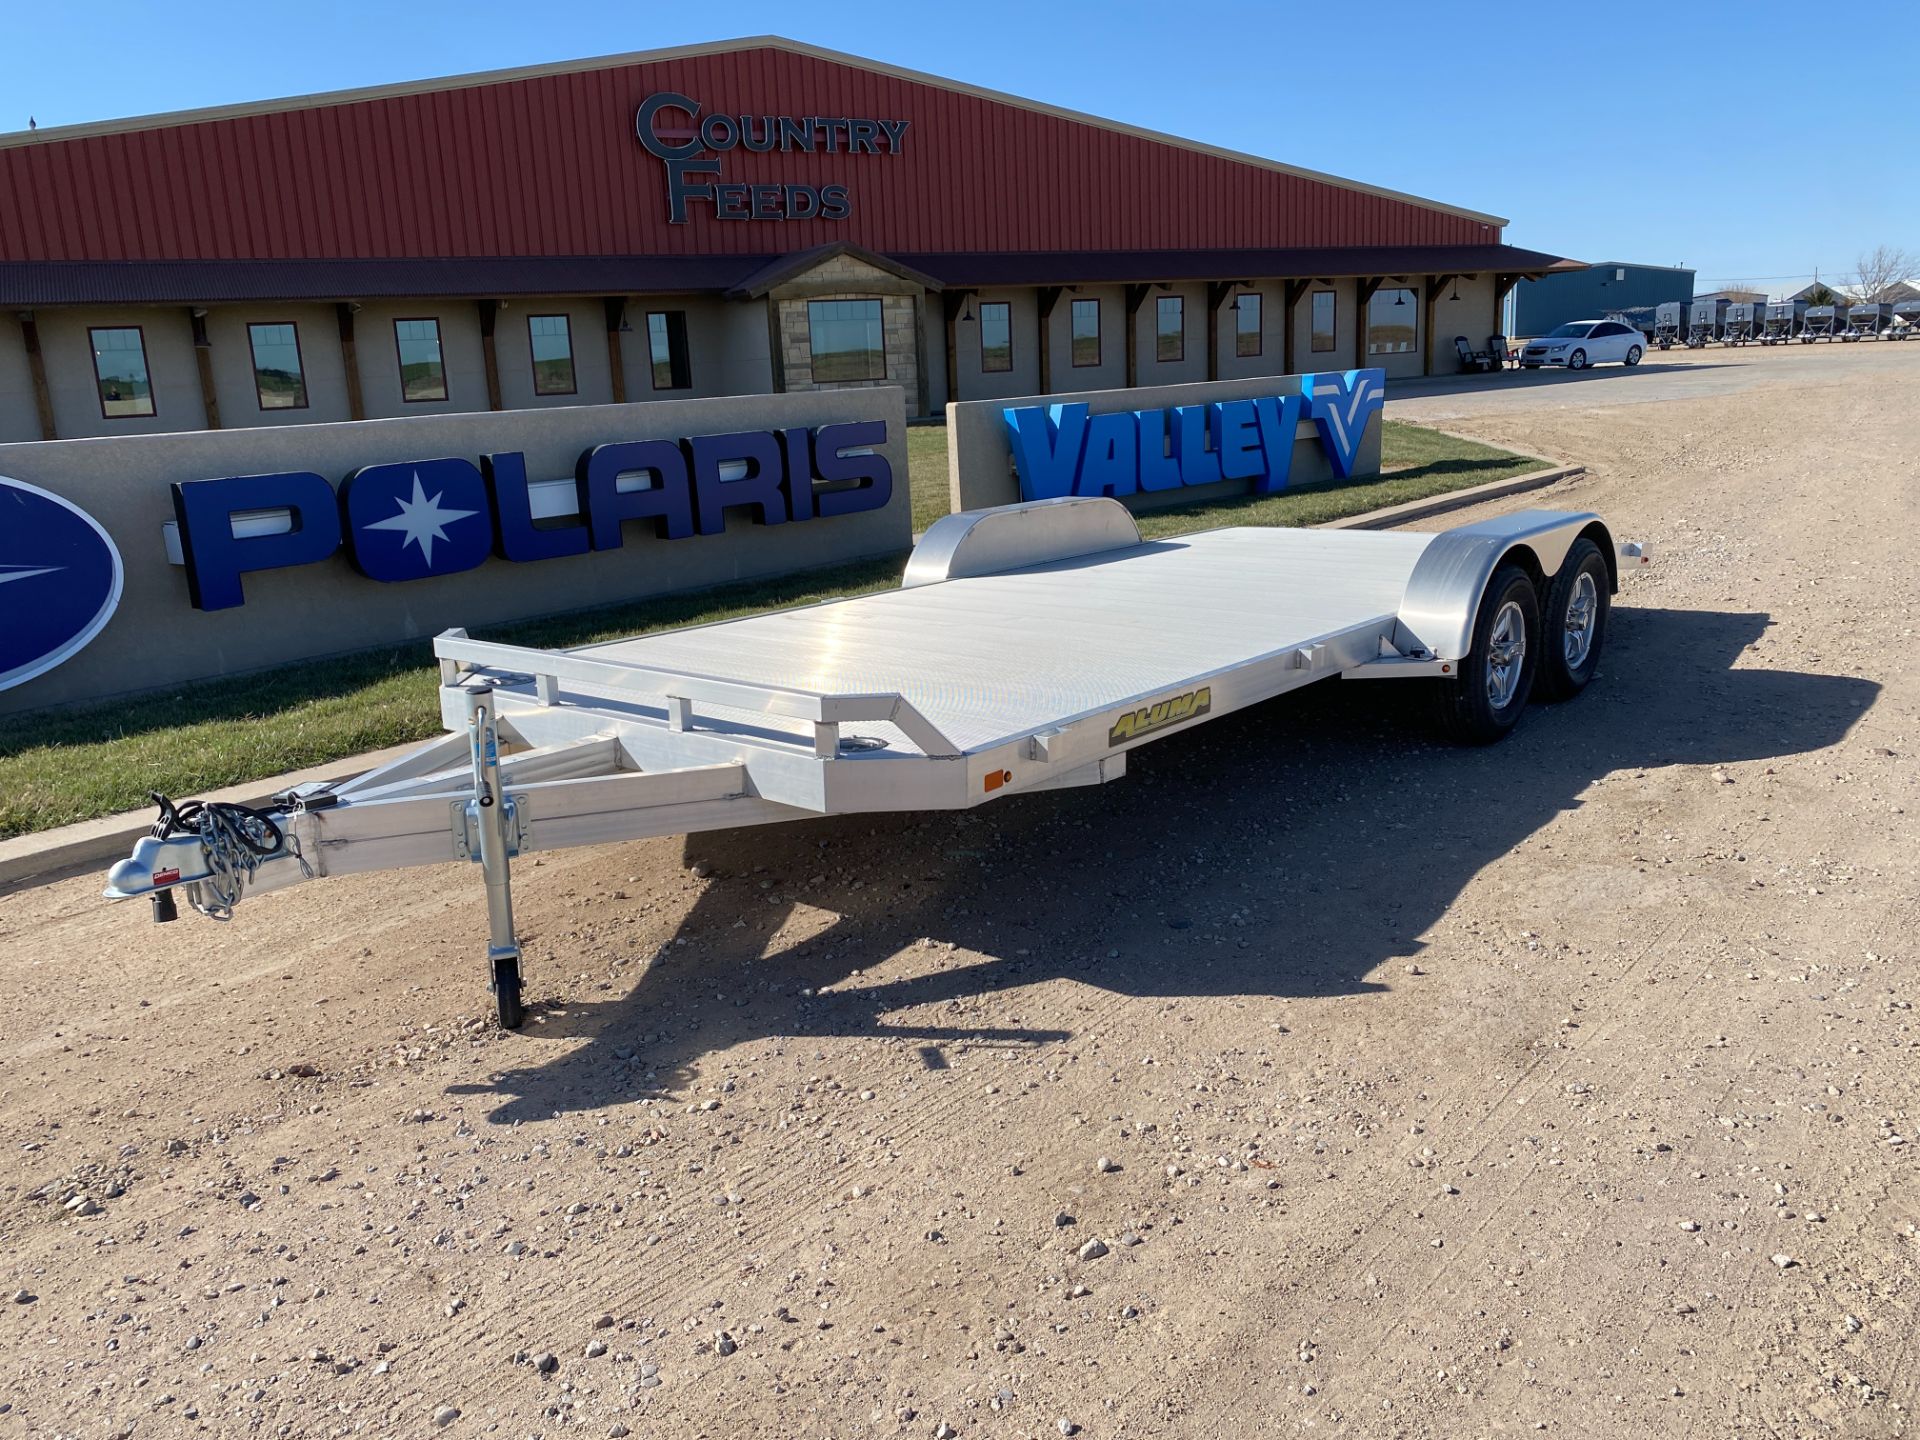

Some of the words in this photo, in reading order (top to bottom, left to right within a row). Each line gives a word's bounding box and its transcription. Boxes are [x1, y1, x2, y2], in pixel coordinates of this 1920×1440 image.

[636, 91, 912, 160] COUNTRY
[664, 156, 850, 225] FEEDS
[1002, 395, 1302, 498] VALLEY
[174, 419, 893, 612] POLARIS
[1111, 687, 1211, 738] ALUMA
